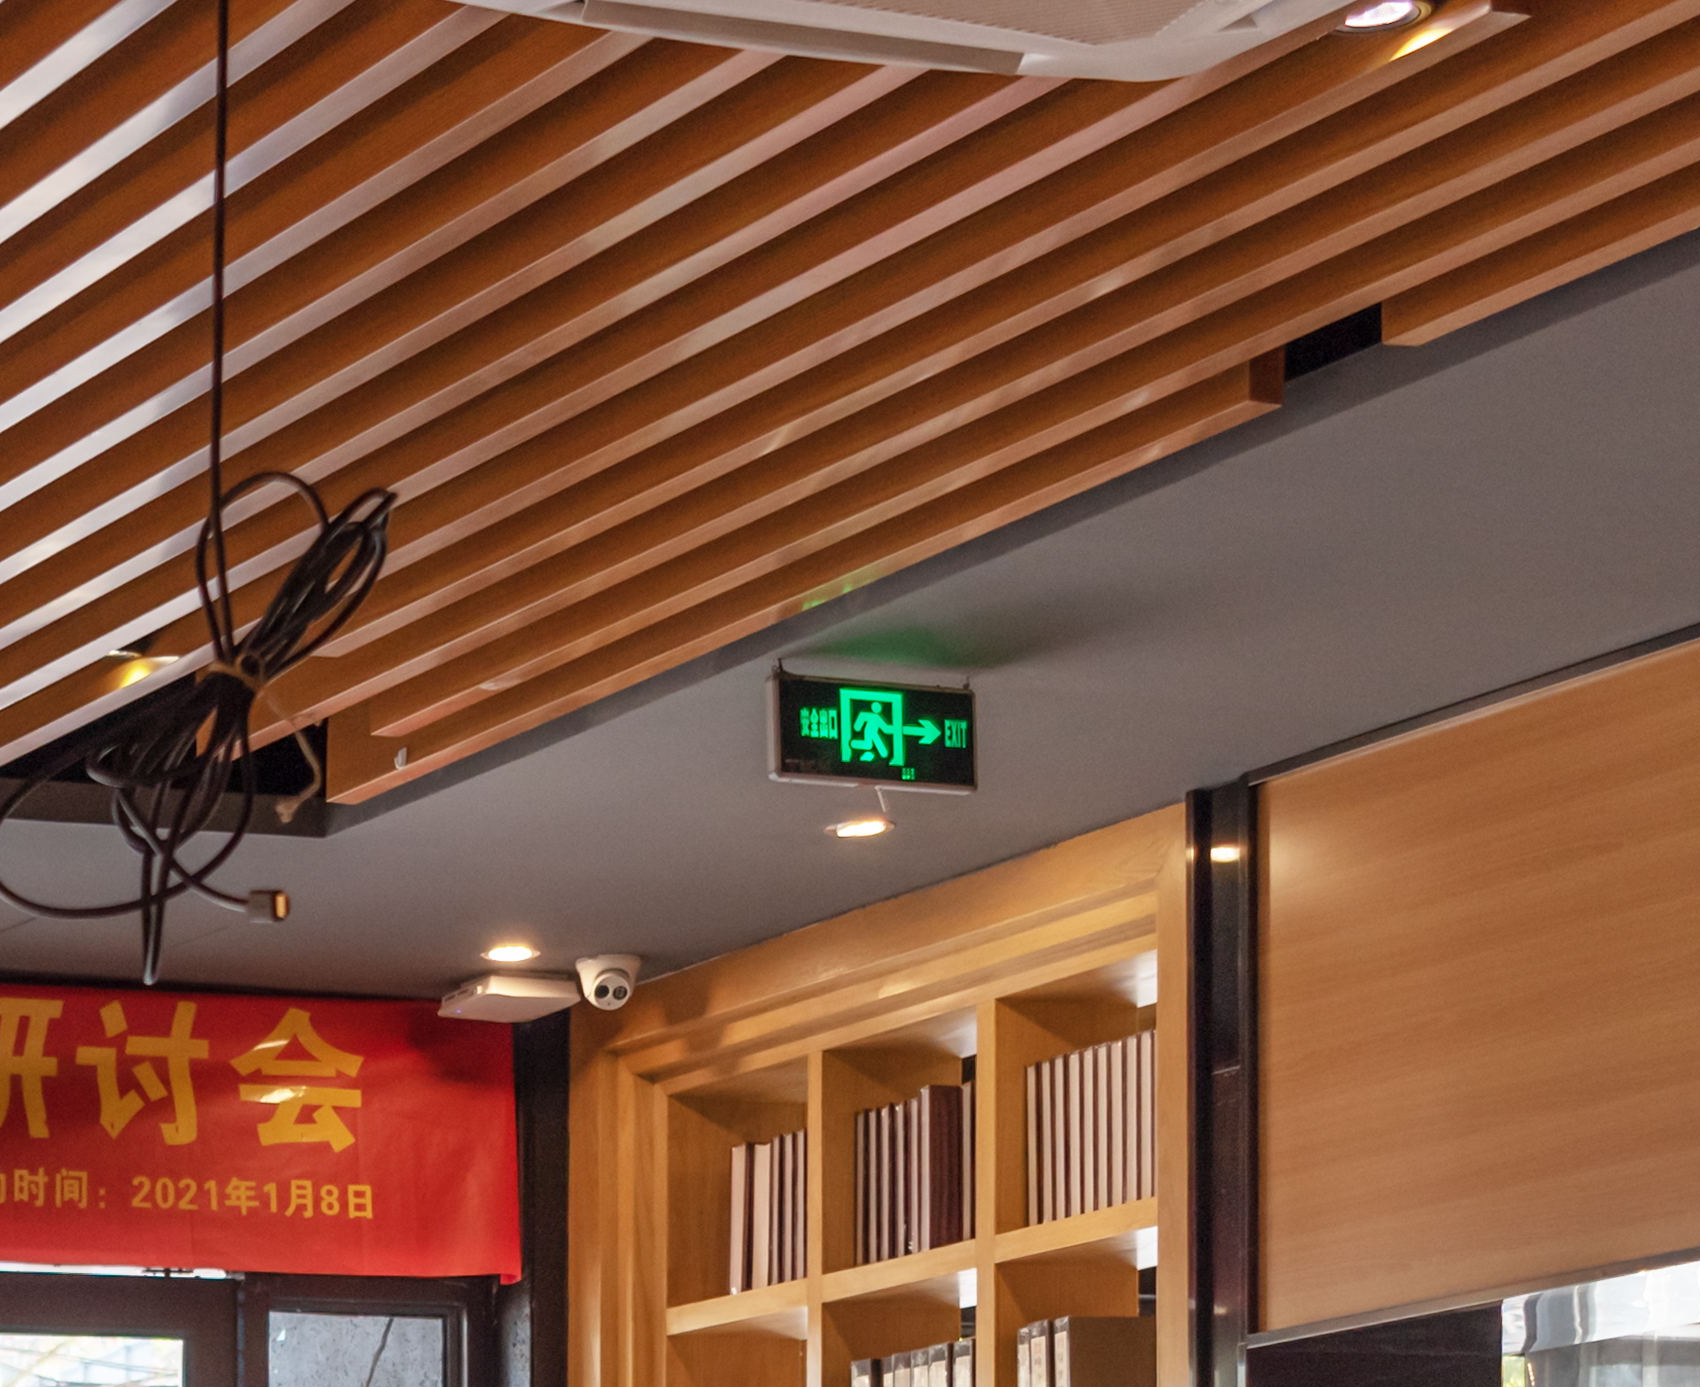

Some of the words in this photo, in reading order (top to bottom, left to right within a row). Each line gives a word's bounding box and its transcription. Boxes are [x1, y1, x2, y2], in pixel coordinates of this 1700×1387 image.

[800, 707, 839, 740] 安全出口
[944, 718, 968, 749] EXIT
